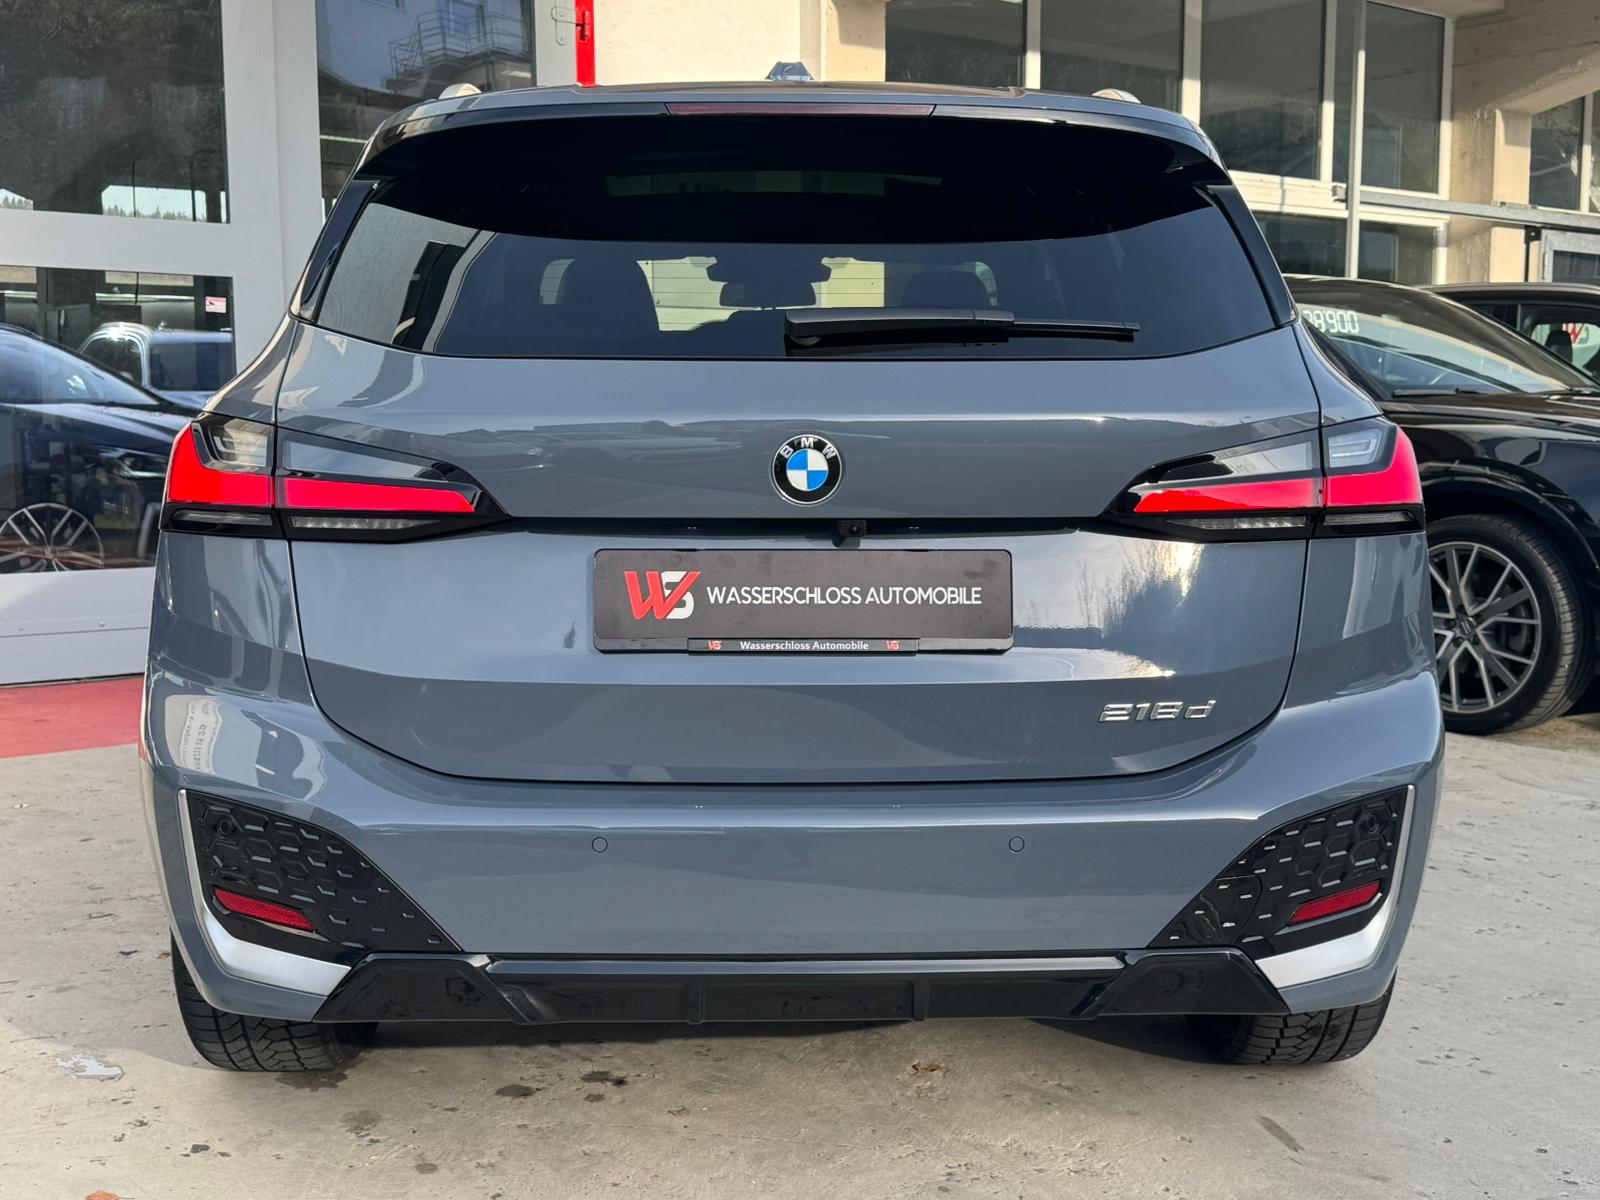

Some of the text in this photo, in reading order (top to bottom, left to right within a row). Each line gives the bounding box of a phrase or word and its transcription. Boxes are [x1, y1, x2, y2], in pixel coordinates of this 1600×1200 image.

[780, 437, 836, 459] BMW
[706, 586, 982, 605] WASSERSCHLOSS AUTOMOBILE
[740, 640, 811, 650] Wasserschloss
[812, 640, 869, 650] Automobile
[1099, 700, 1217, 721] 218d
